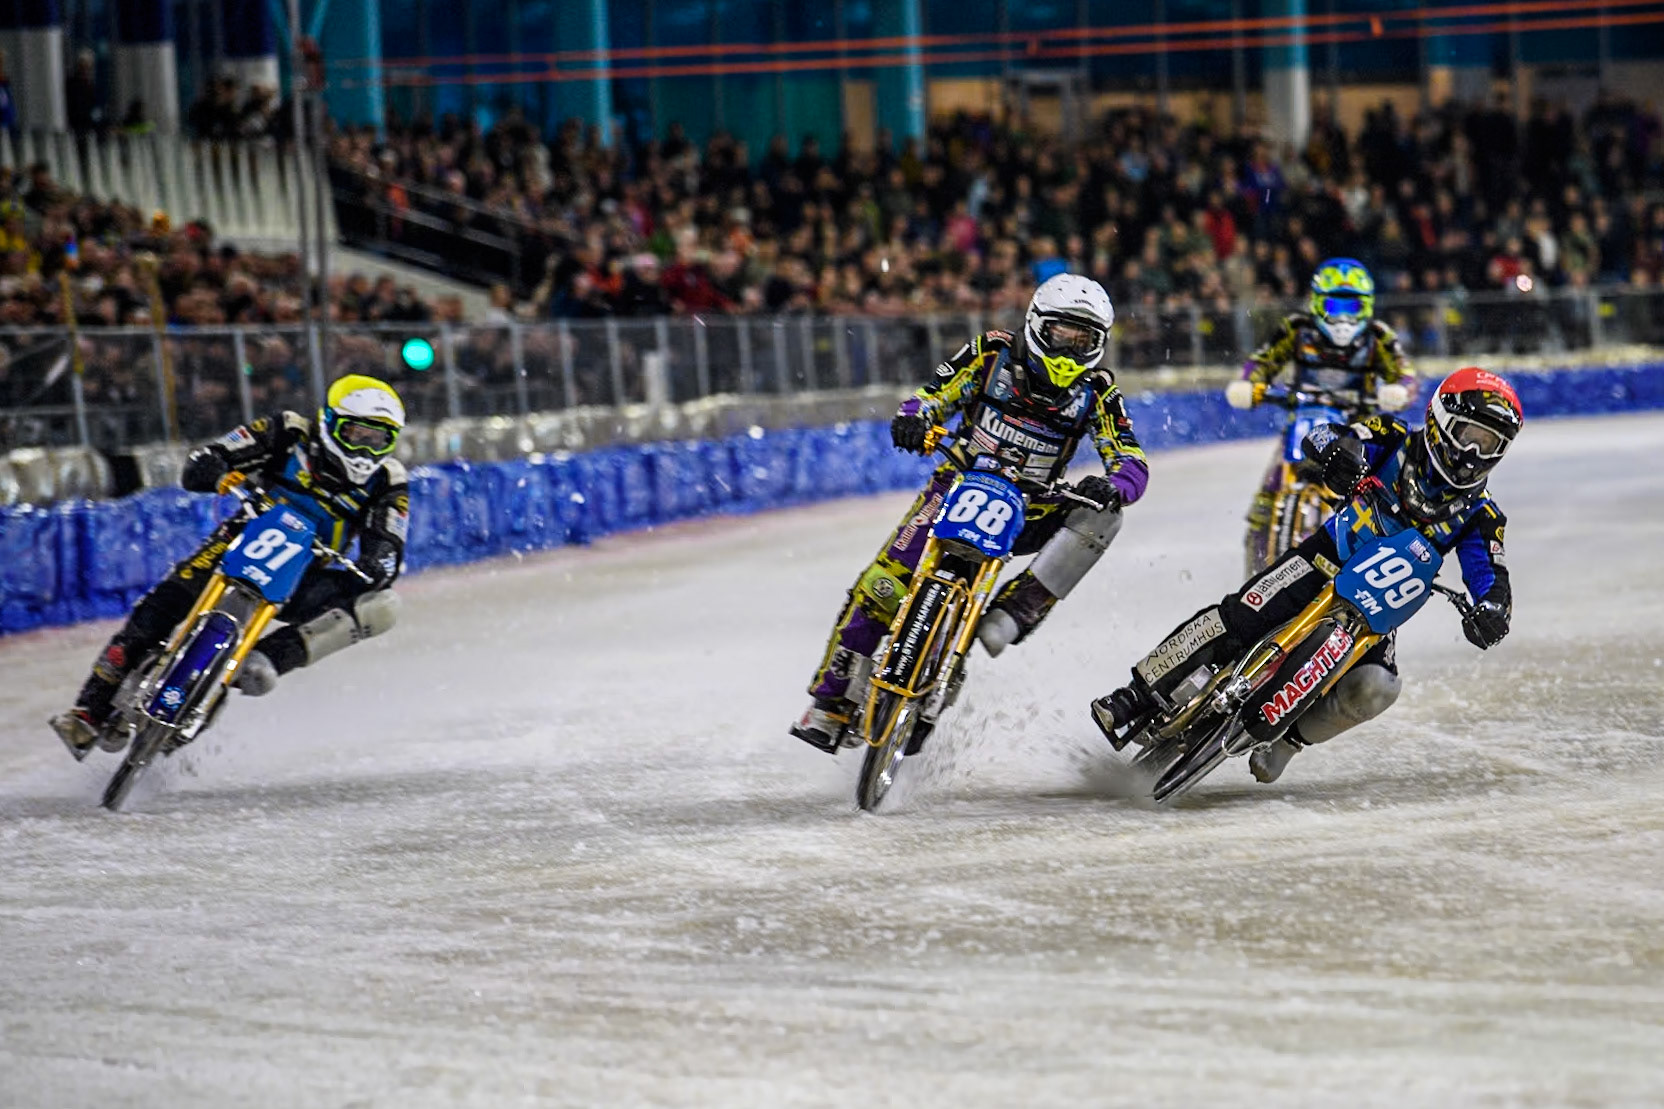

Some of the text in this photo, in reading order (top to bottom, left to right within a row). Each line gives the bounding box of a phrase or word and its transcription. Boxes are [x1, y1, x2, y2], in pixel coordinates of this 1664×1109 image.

[980, 406, 1059, 455] Kunemann
[946, 489, 1014, 536] 88
[242, 528, 304, 571] 81
[1352, 546, 1426, 610] 199
[1354, 589, 1383, 616] FIM
[1144, 621, 1224, 684] CENTRUMHUS
[1145, 615, 1211, 666] NORDISKA
